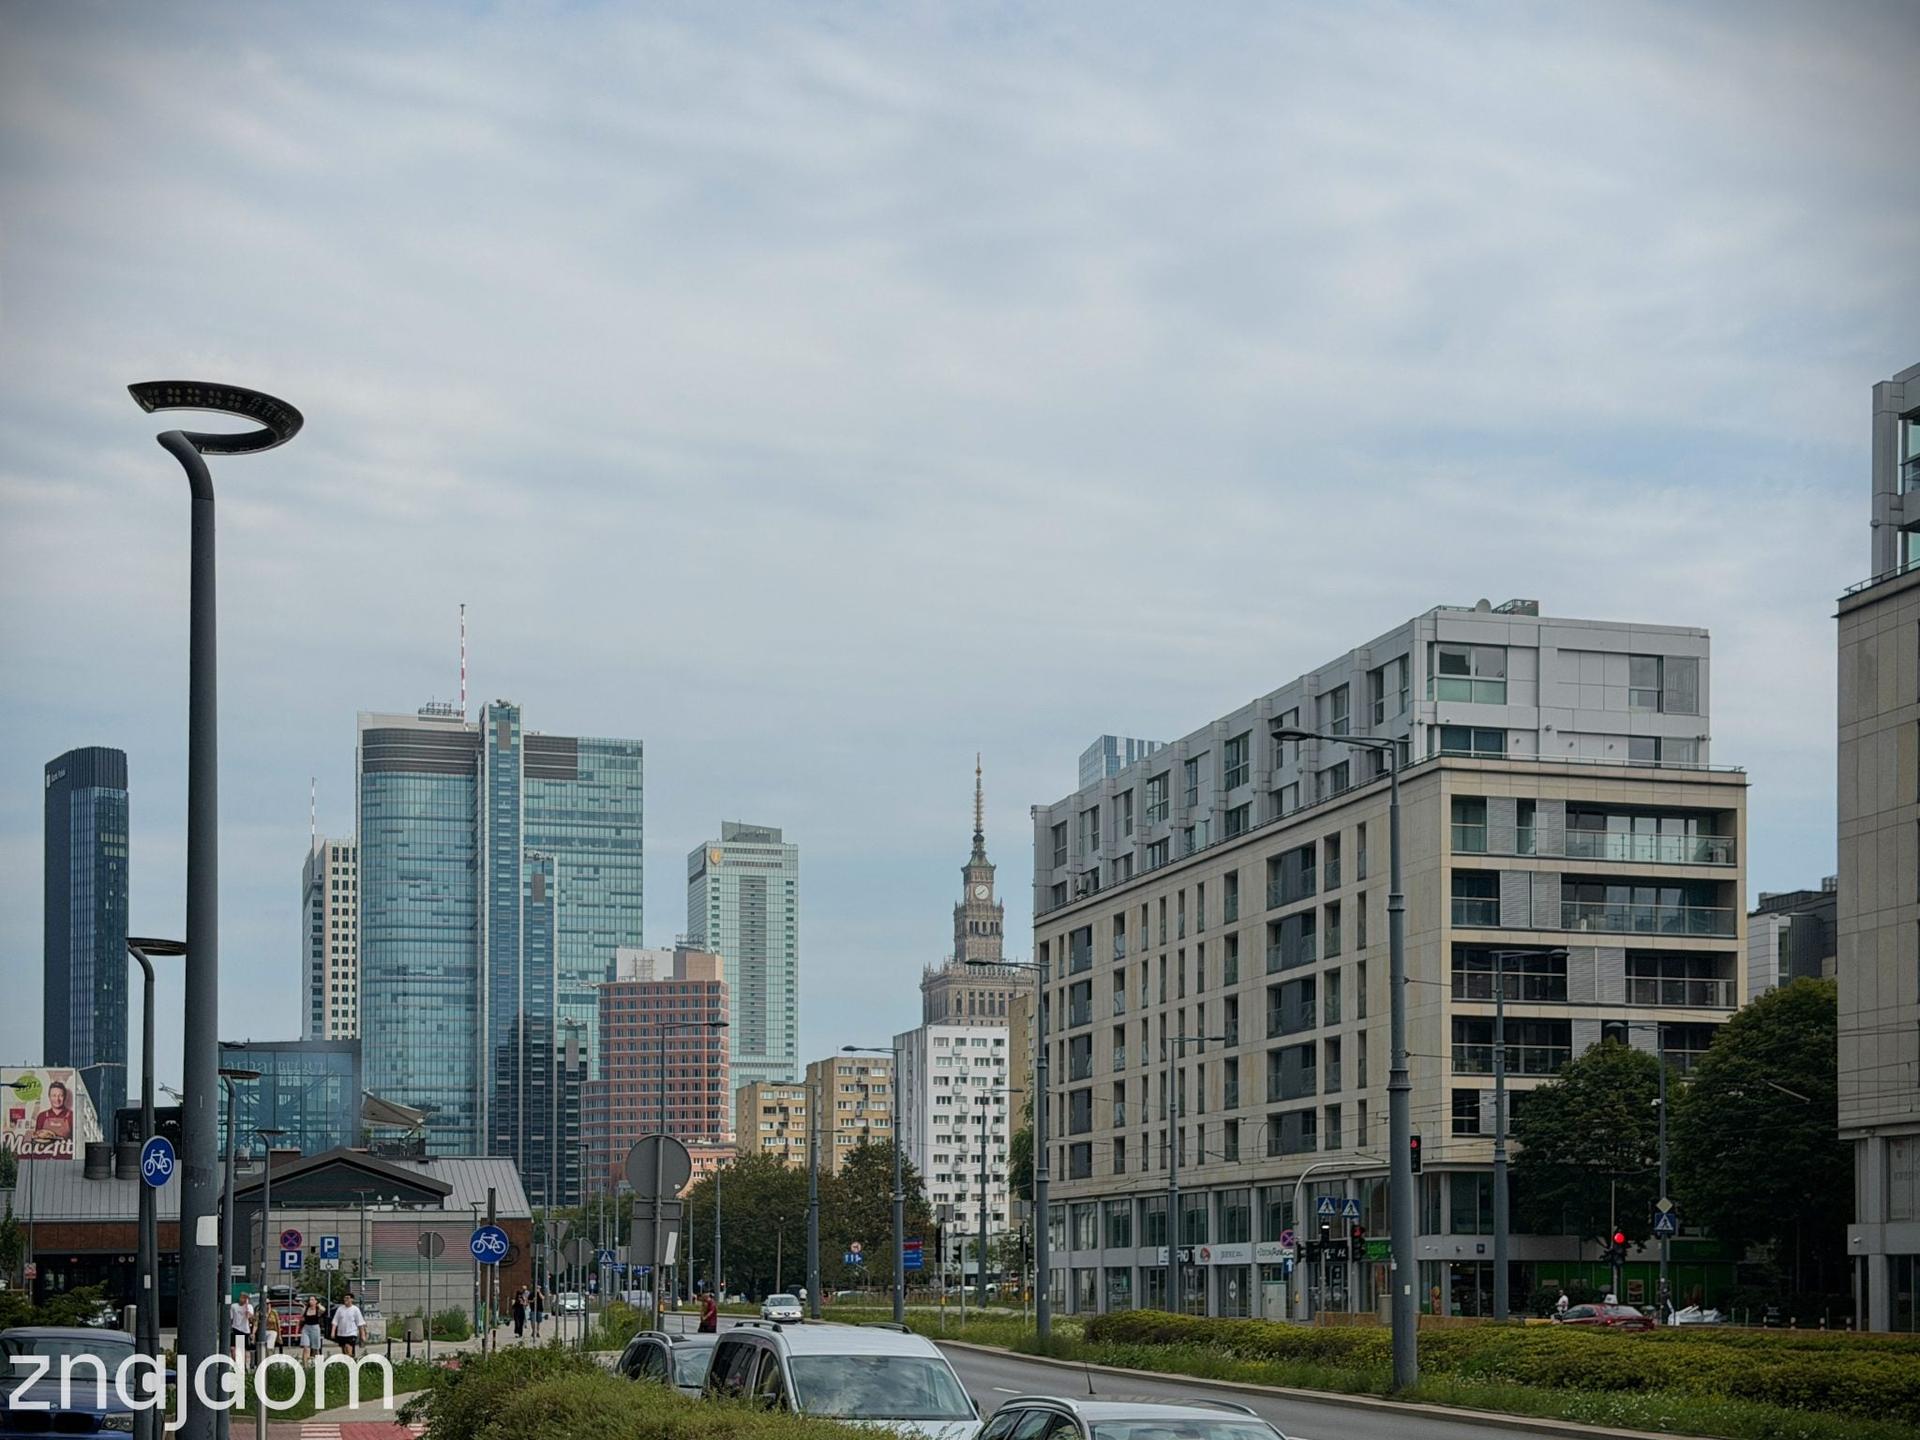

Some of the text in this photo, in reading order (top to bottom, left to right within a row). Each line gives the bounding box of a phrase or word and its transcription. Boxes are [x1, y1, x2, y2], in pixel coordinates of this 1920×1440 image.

[1, 1131, 74, 1157] Maczfit
[323, 1238, 336, 1253] P
[284, 1251, 298, 1269] P
